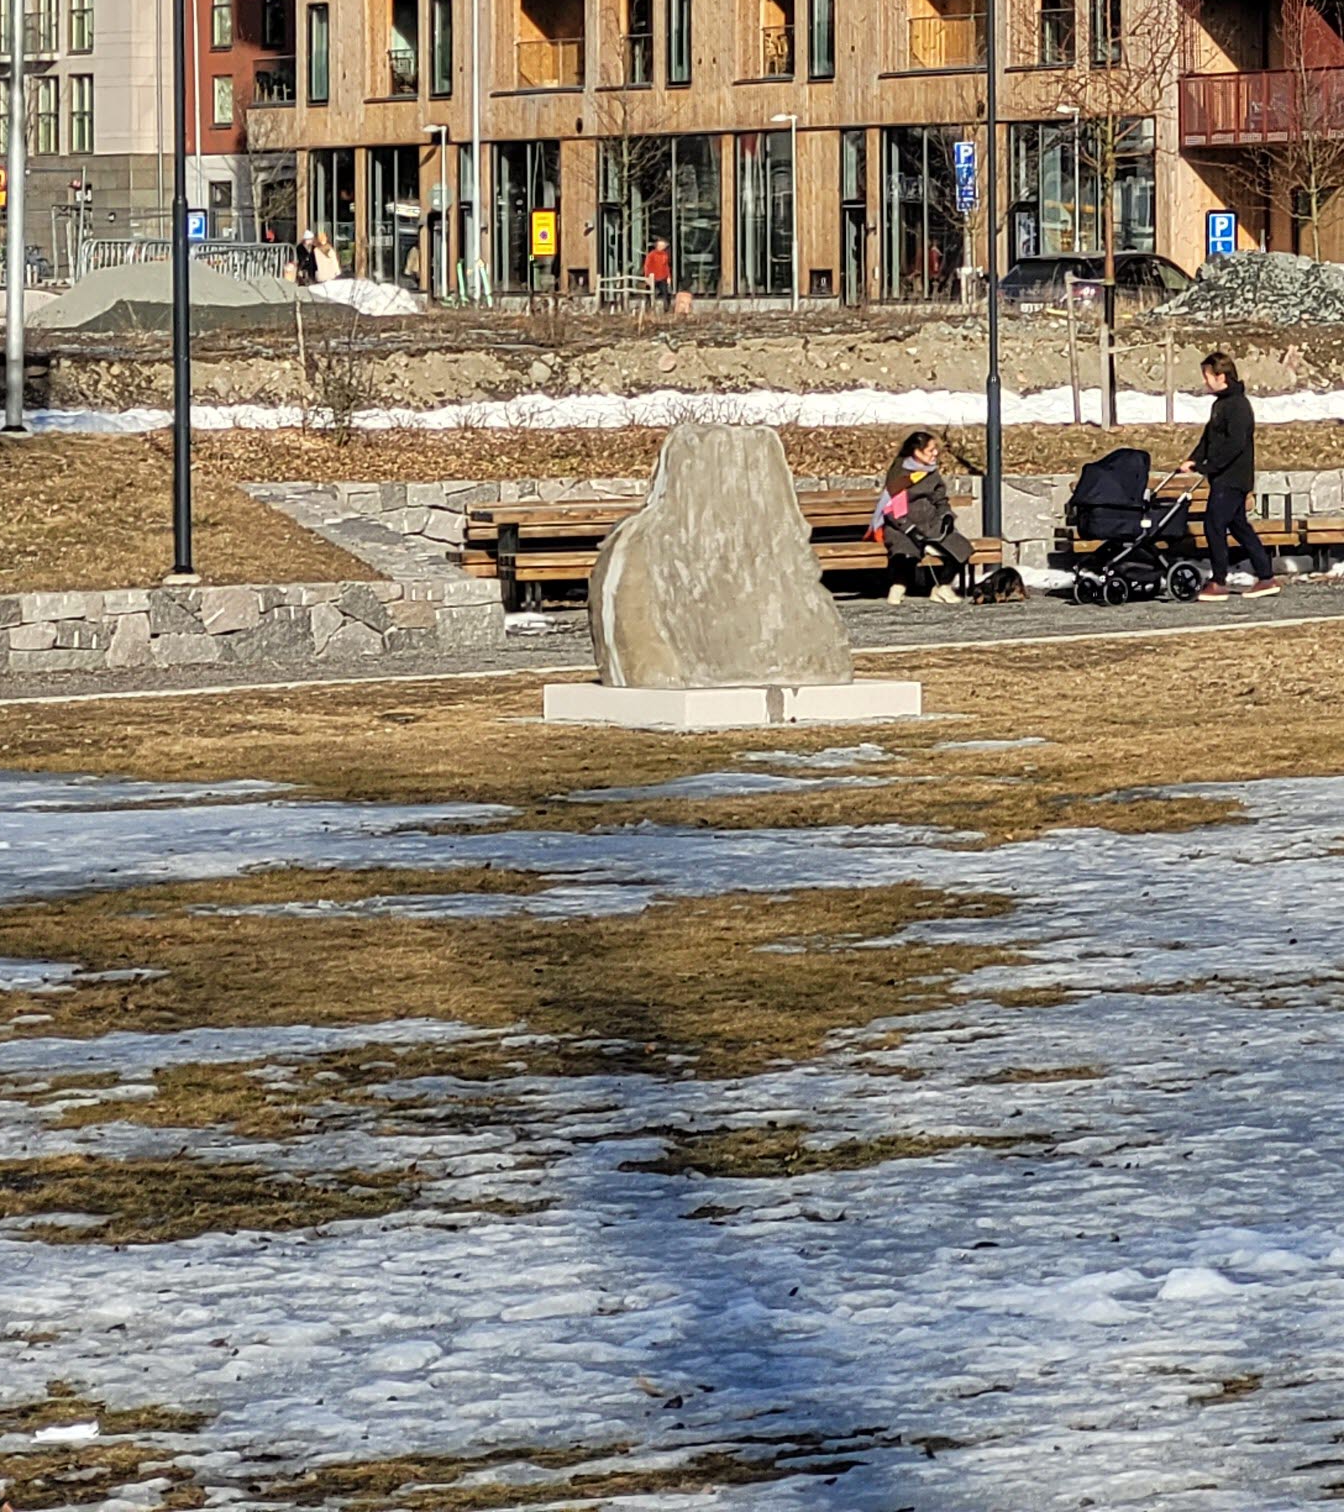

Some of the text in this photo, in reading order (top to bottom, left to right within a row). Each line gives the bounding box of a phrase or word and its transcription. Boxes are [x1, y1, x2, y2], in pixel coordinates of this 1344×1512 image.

[959, 145, 973, 164] P
[188, 217, 201, 234] P
[1215, 216, 1229, 237] P
